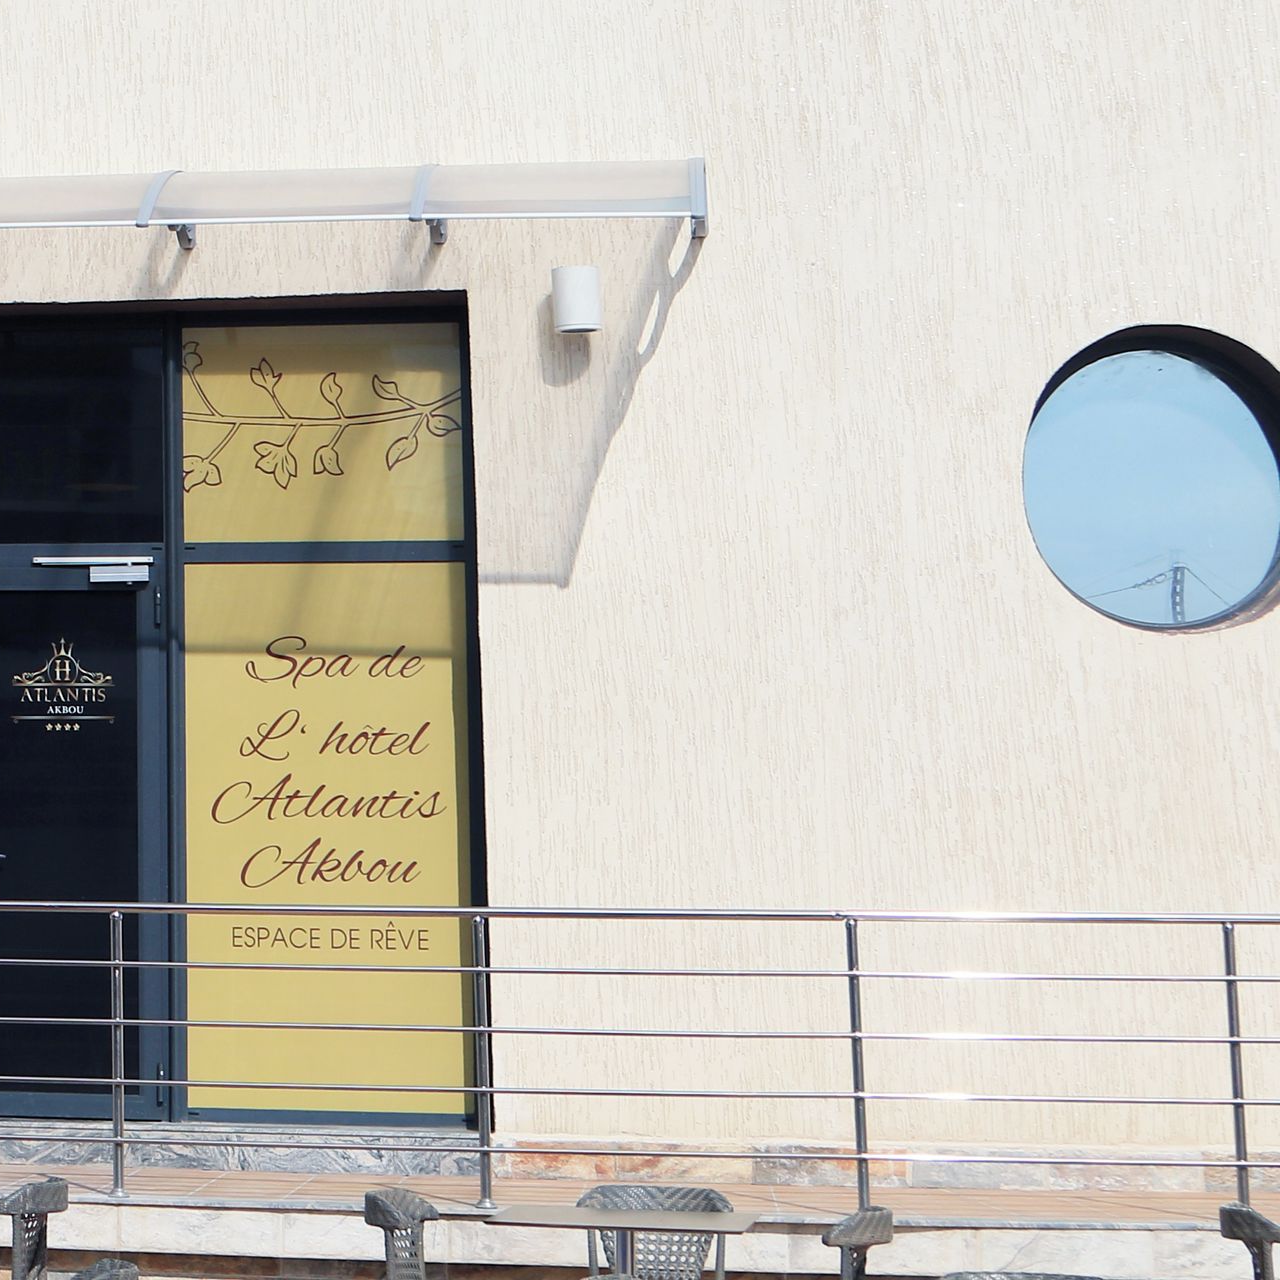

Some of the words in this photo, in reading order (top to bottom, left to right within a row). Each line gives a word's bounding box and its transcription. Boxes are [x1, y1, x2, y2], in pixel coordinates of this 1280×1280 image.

[55, 659, 71, 681] H
[245, 635, 361, 689] Spa
[368, 644, 425, 679] de
[21, 687, 106, 703] ATLANTIS
[47, 705, 84, 715] AKBOU
[319, 720, 431, 756] hôtel
[210, 773, 448, 825] Atlantis
[240, 837, 422, 889] Akbou
[232, 926, 321, 949] ESPACE
[330, 928, 361, 950] DE
[370, 921, 430, 951] RÊVE
